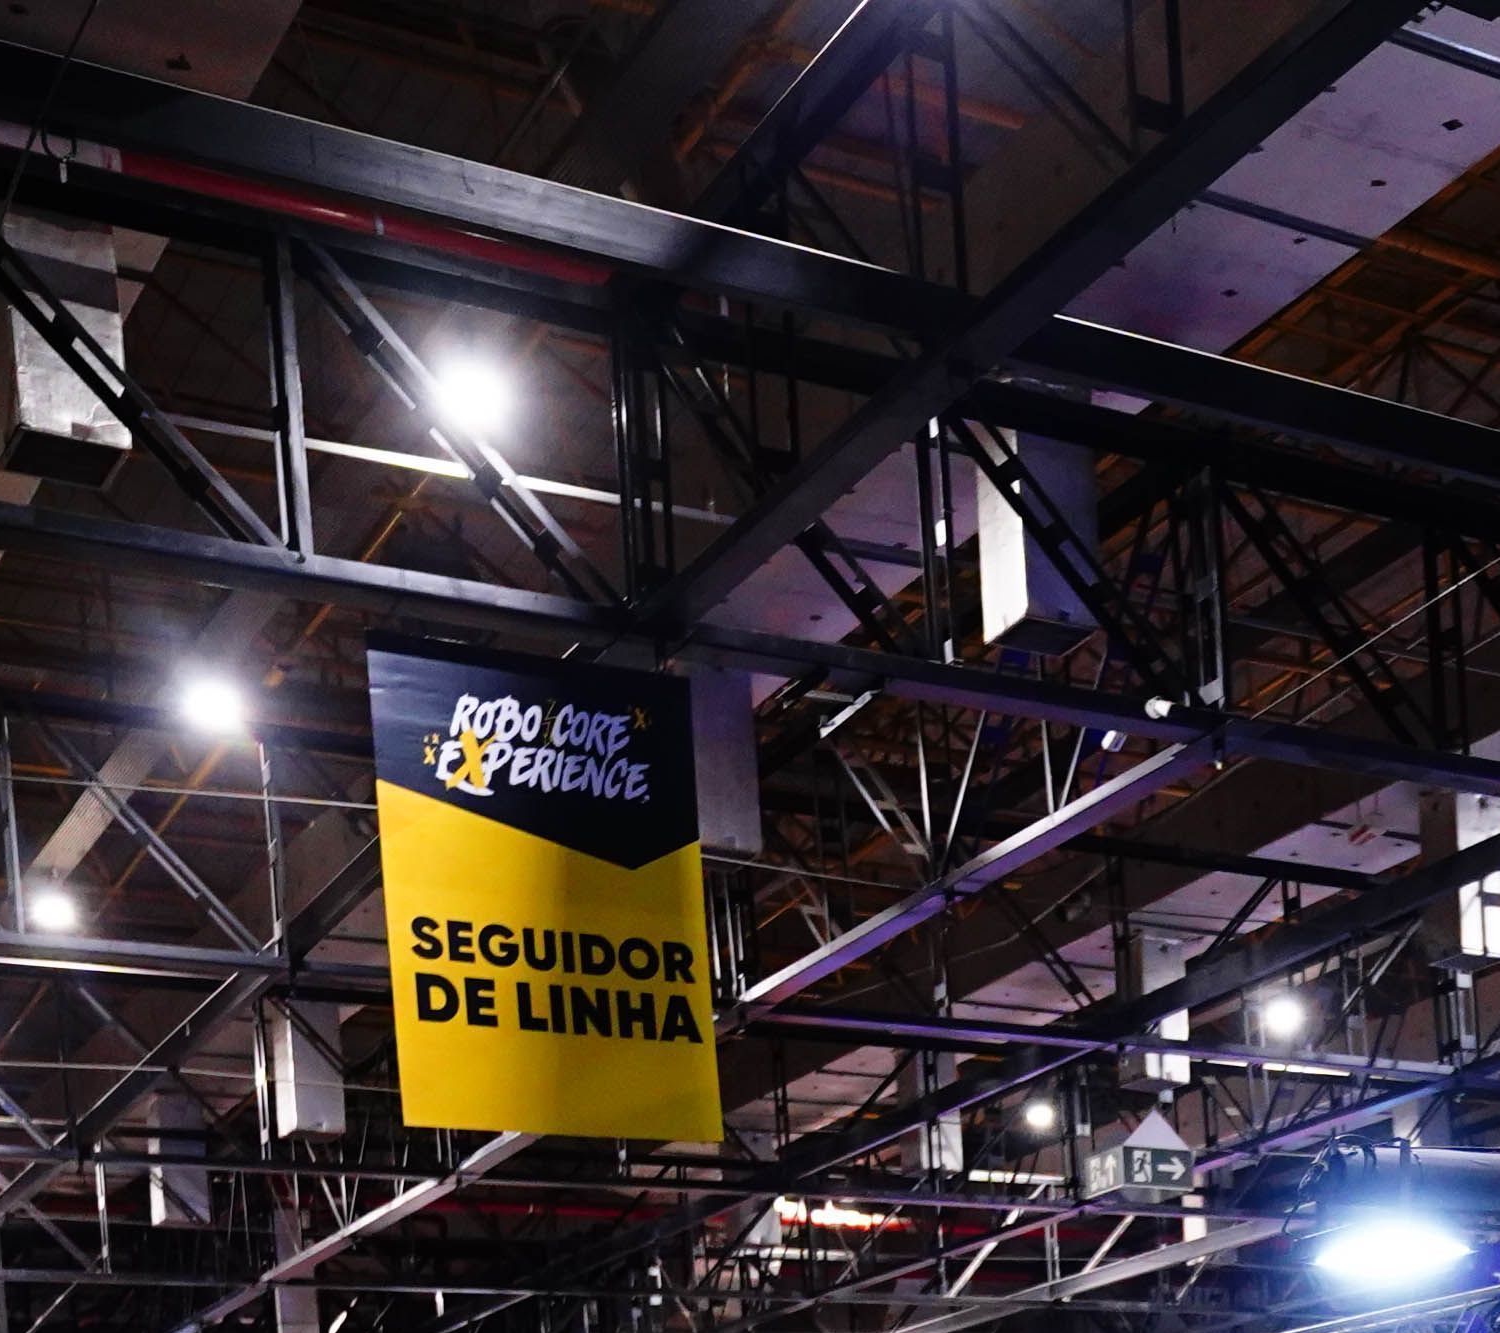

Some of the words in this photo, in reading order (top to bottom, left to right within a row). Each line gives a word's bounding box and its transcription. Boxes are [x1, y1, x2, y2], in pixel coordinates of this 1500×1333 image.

[450, 693, 541, 740] ROBO
[551, 702, 631, 756] CORE
[411, 916, 696, 984] SEGUIDOR
[415, 972, 499, 1028] DE
[517, 982, 703, 1044] LINHA
